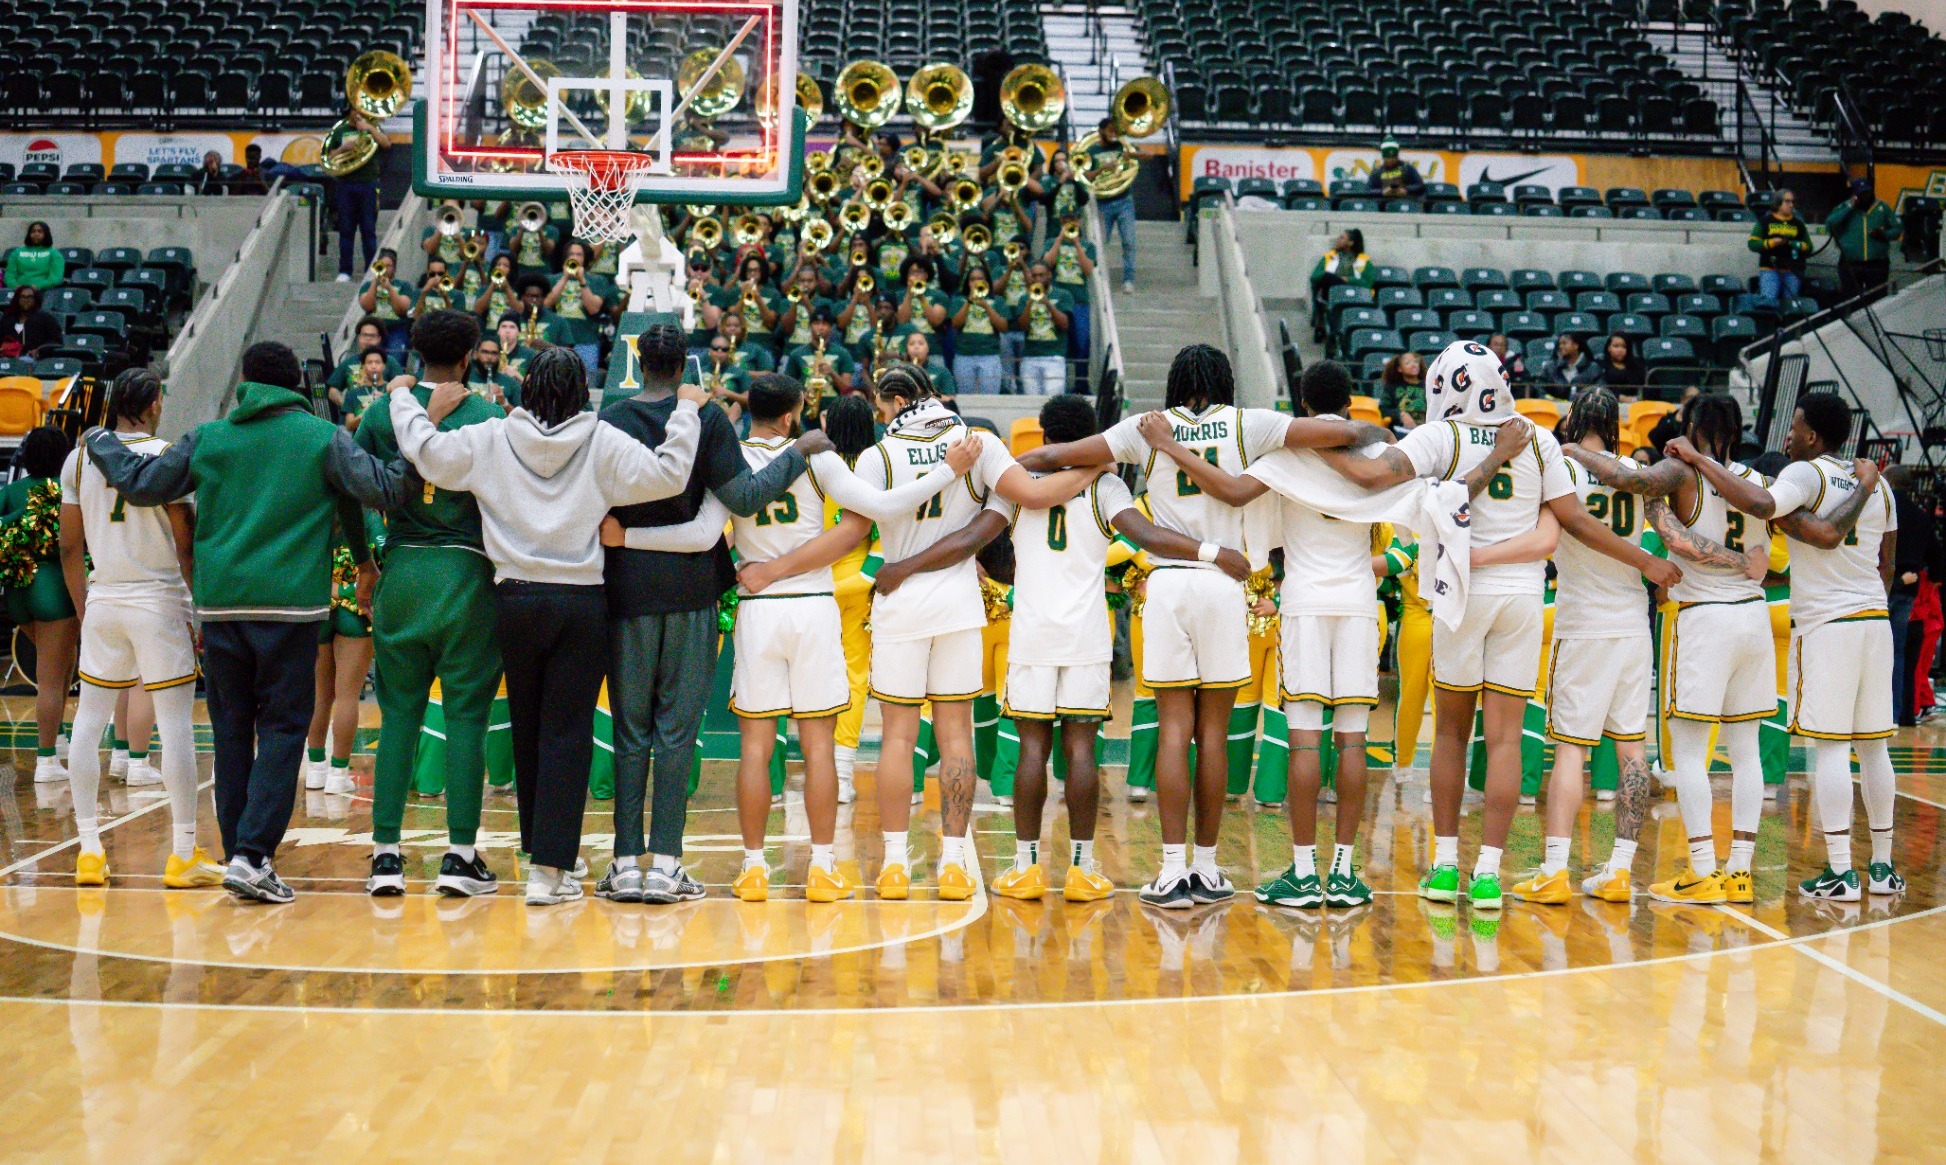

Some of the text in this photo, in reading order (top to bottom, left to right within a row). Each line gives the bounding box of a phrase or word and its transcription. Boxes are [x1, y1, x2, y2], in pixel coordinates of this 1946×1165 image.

[26, 153, 60, 162] PEPSI
[438, 175, 473, 183] SPALDING
[1204, 159, 1299, 179] Banister
[907, 443, 948, 465] ELLIS
[1586, 490, 1635, 538] 20
[1047, 503, 1067, 552] 0
[1725, 509, 1745, 554] 2
